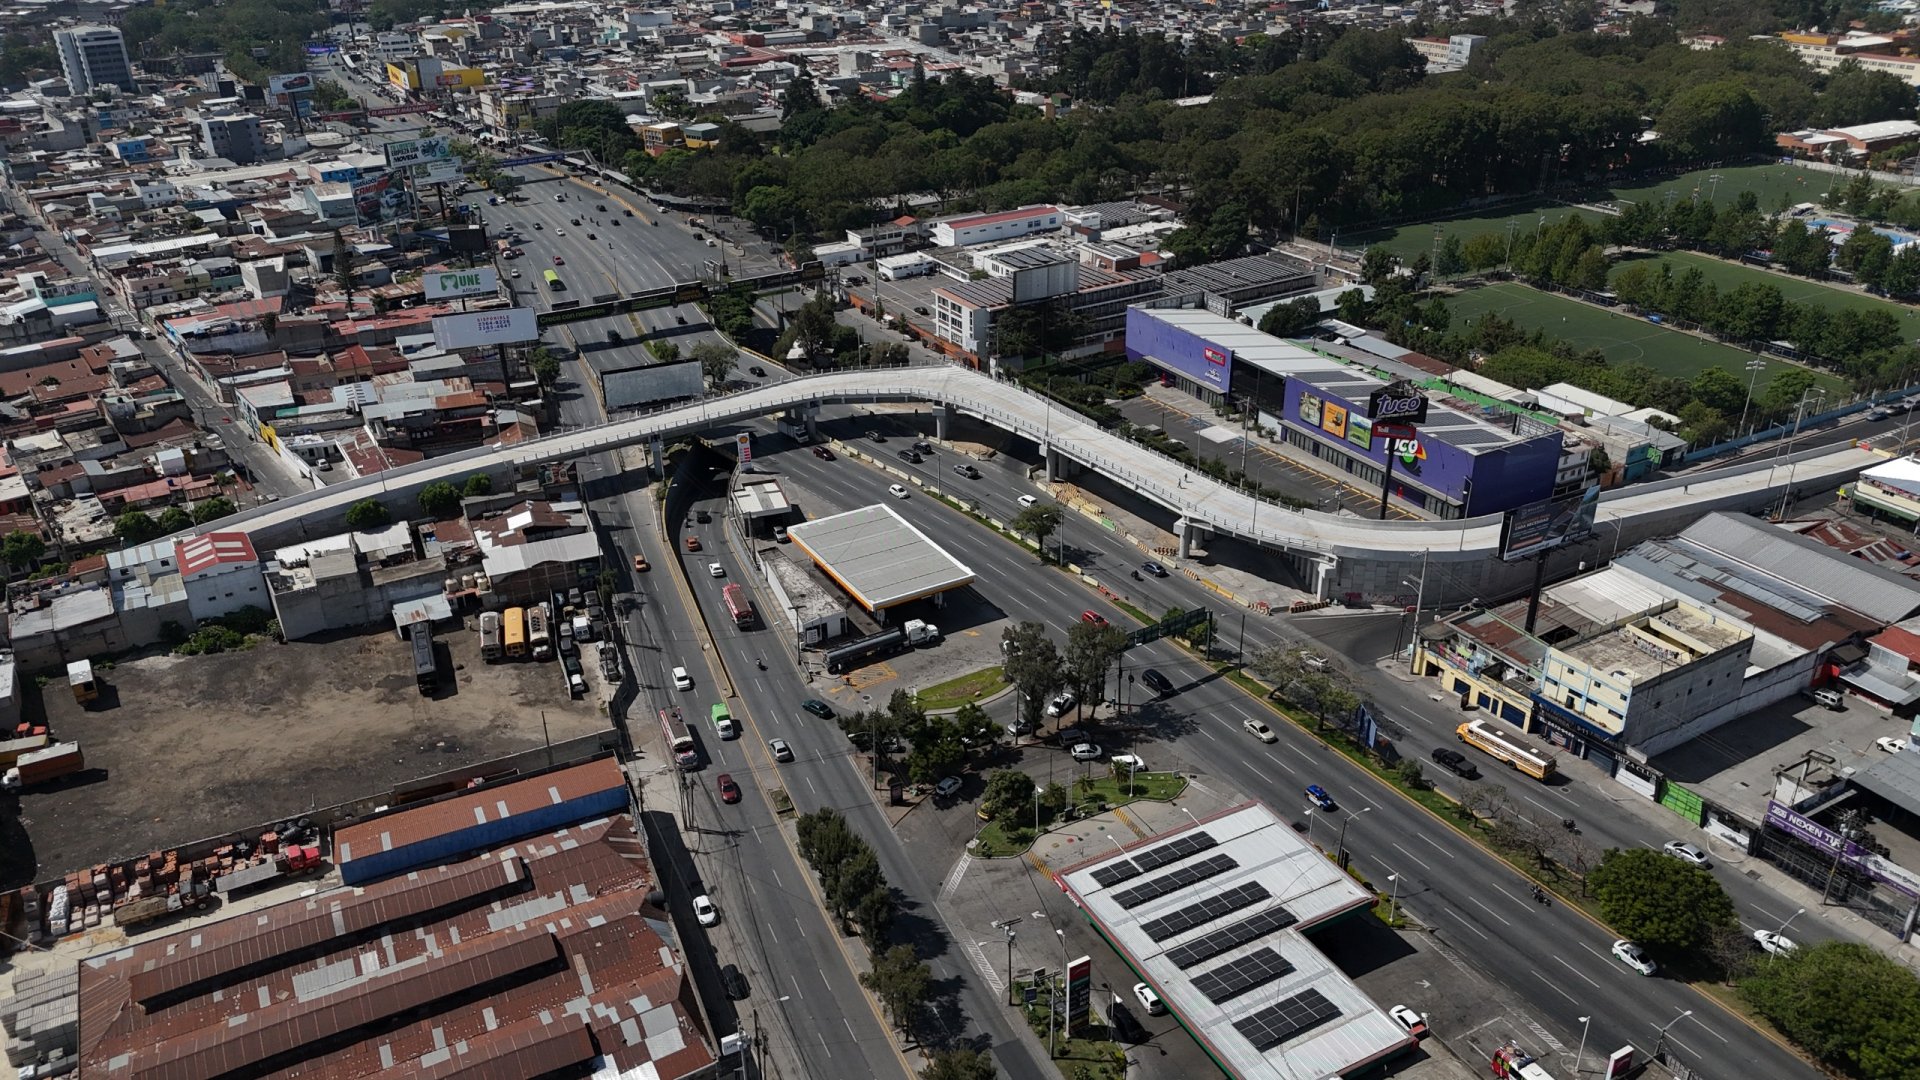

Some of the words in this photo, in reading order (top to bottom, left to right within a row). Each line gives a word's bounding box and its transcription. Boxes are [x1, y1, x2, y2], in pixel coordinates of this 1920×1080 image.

[393, 153, 419, 162] MOVESA
[458, 273, 481, 287] UNE
[539, 312, 562, 324] Crece
[562, 312, 575, 321] con
[1789, 815, 1823, 838] NEXEN
